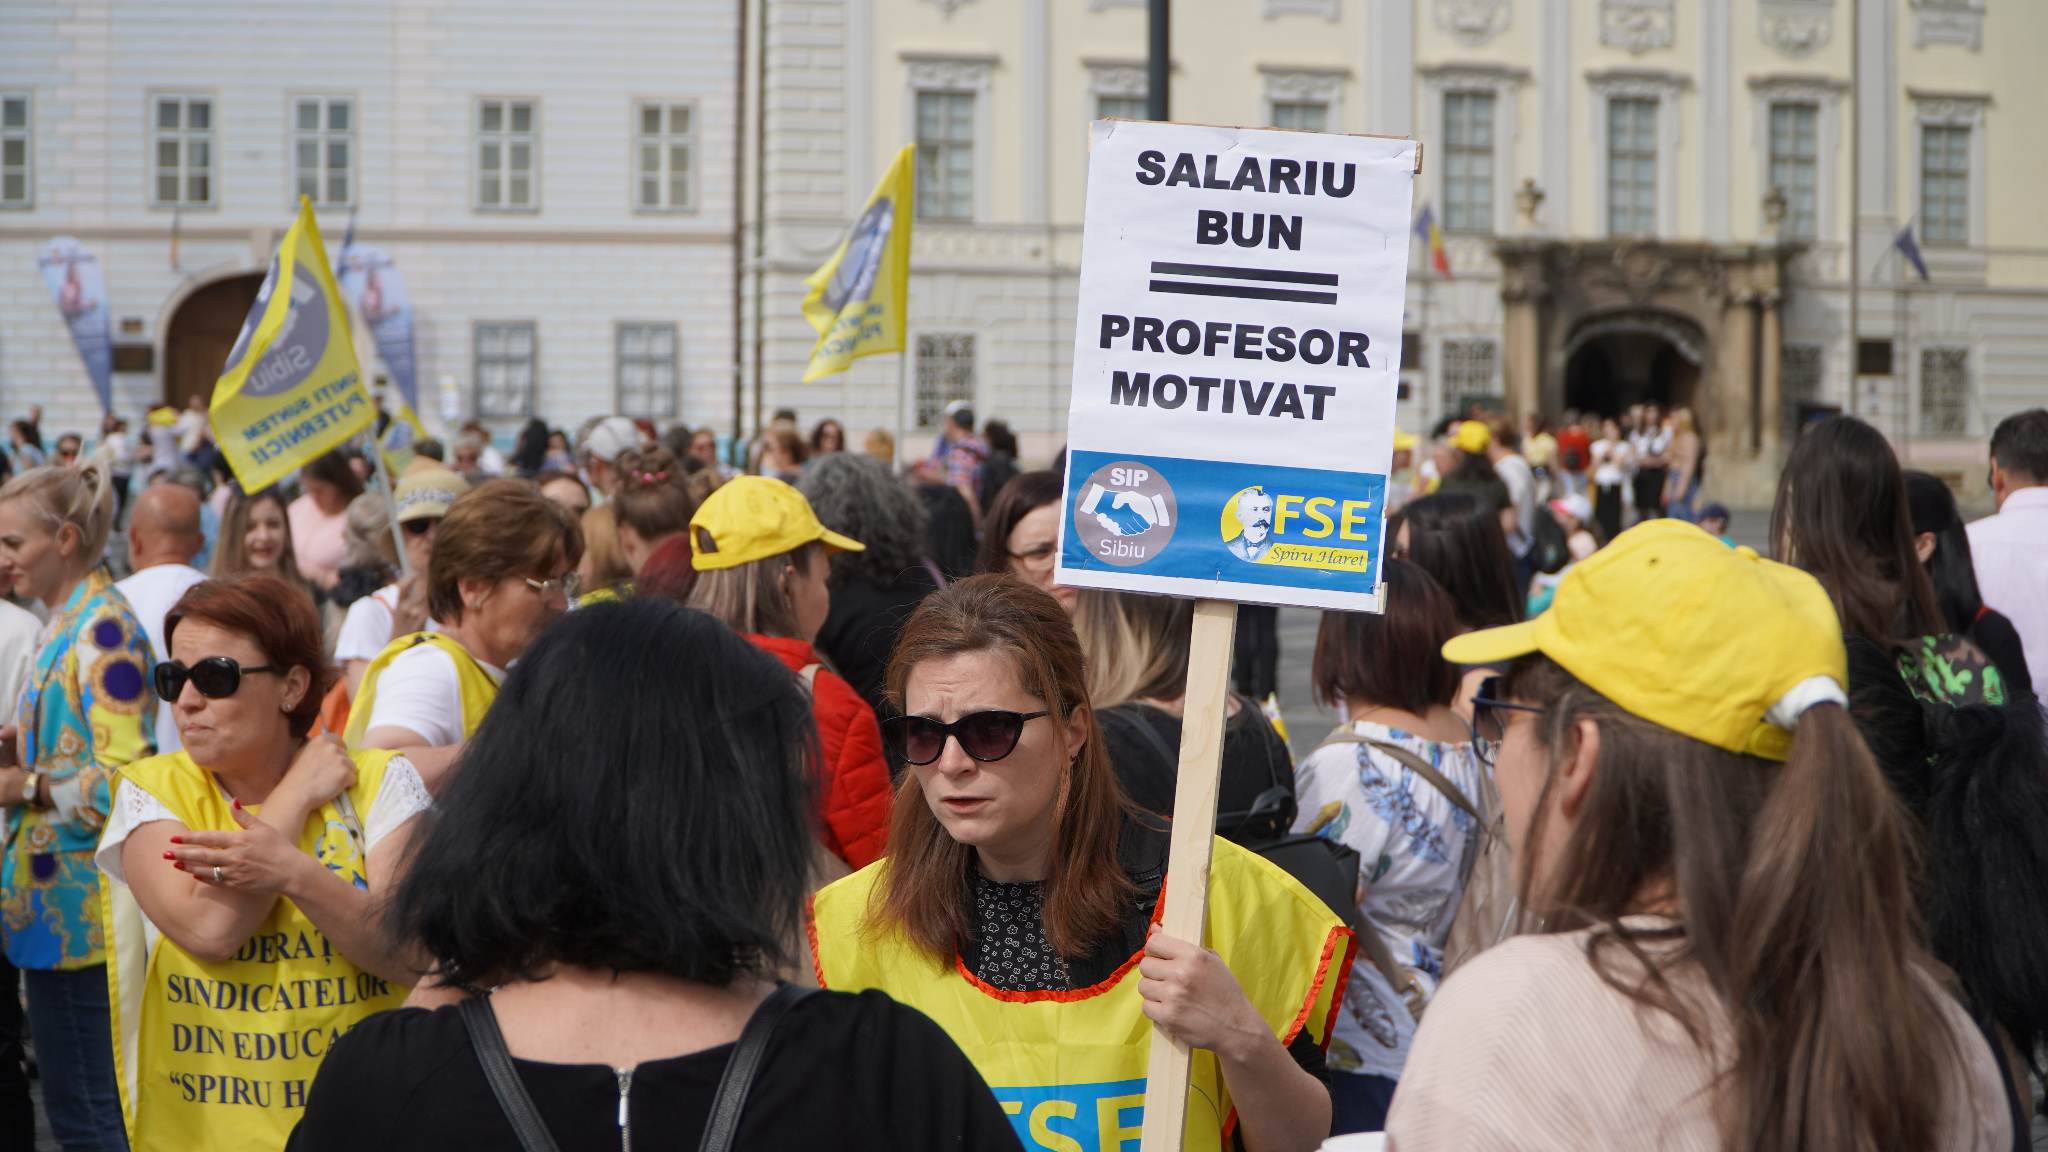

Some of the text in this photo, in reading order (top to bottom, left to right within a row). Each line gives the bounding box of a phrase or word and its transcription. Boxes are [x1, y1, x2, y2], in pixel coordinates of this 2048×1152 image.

[1135, 150, 1356, 198] SALARIU
[1196, 209, 1303, 251] BUN
[1100, 314, 1371, 368] PROFESOR
[1110, 370, 1336, 420] MOTIVAT
[1109, 467, 1149, 488] SIP
[1273, 494, 1371, 542] FSE
[1099, 539, 1145, 559] Sibiu
[1270, 546, 1365, 567] Spiru Haret
[230, 929, 344, 966] DERAȚ
[168, 971, 391, 1013] SINDICATELOR
[172, 1023, 355, 1061] DIN EDUCA
[281, 1079, 308, 1109] H
